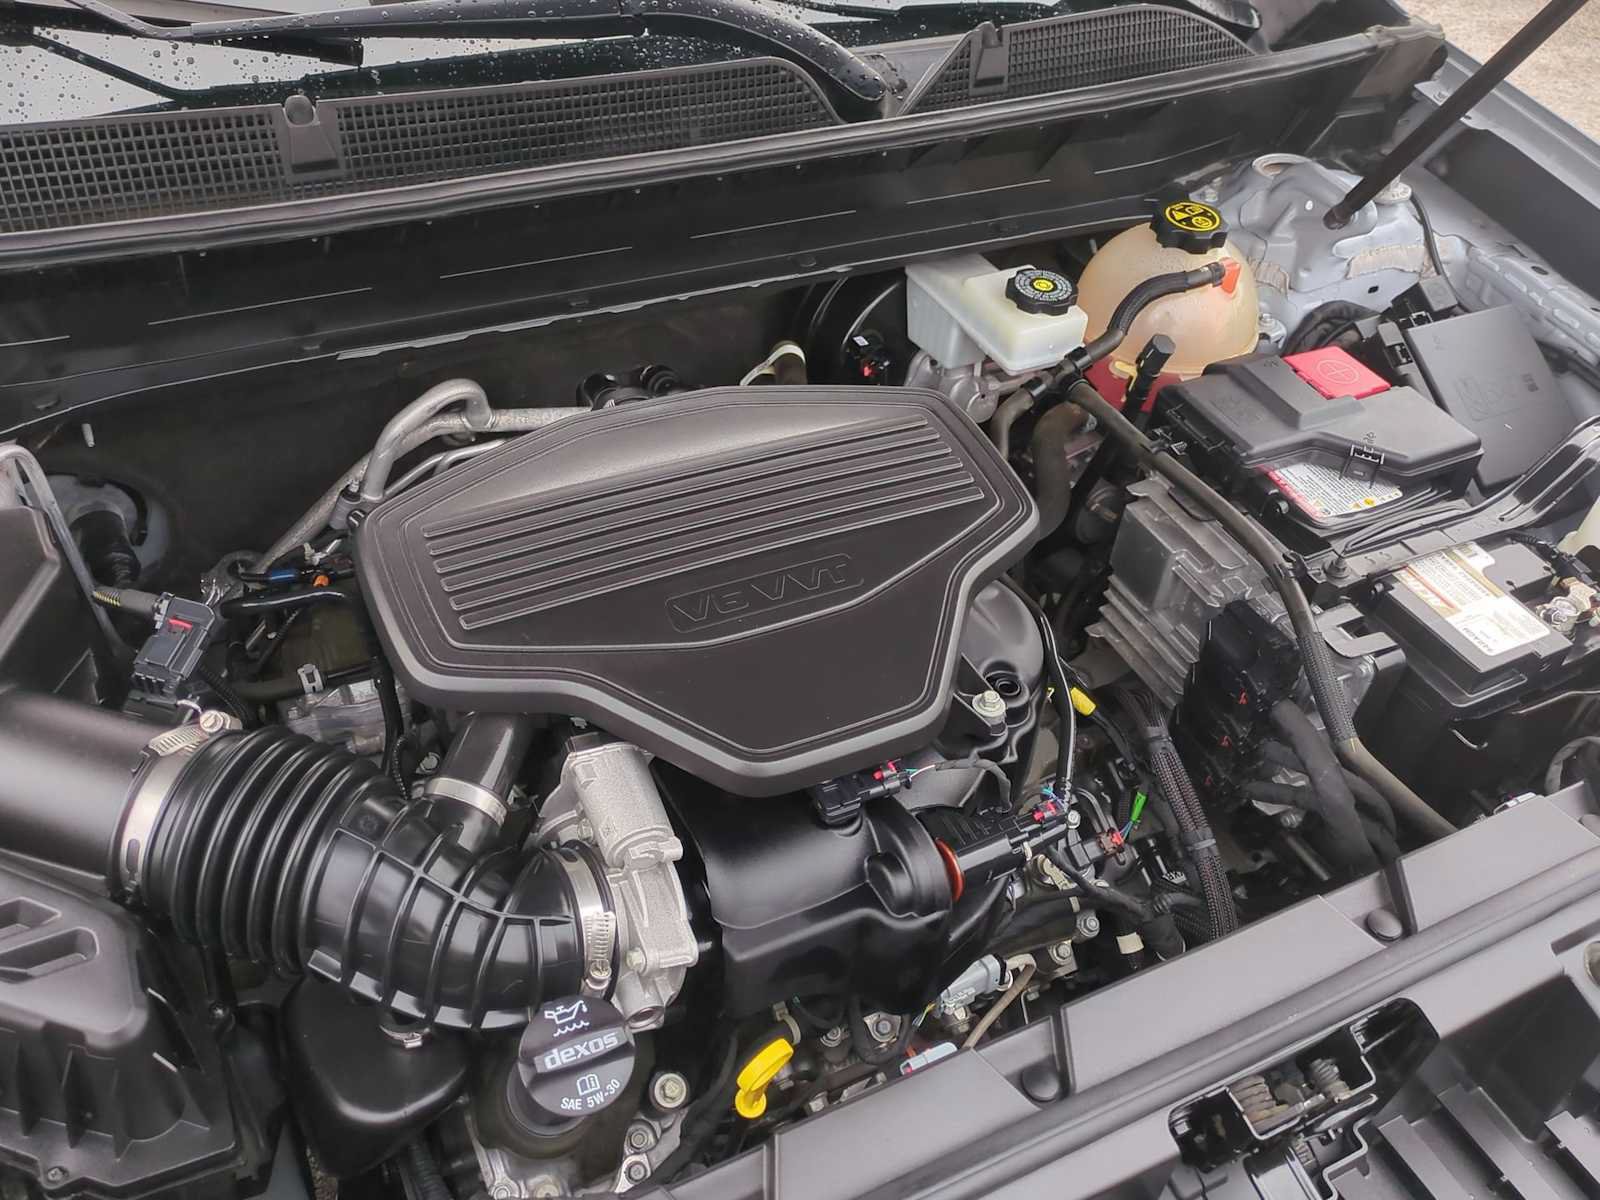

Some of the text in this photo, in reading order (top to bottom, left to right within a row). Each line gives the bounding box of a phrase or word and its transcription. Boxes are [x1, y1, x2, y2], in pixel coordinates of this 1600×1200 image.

[672, 563, 847, 622] V6 VVT
[543, 1031, 619, 1070] dexos
[560, 1078, 621, 1111] SAE 5W-30
